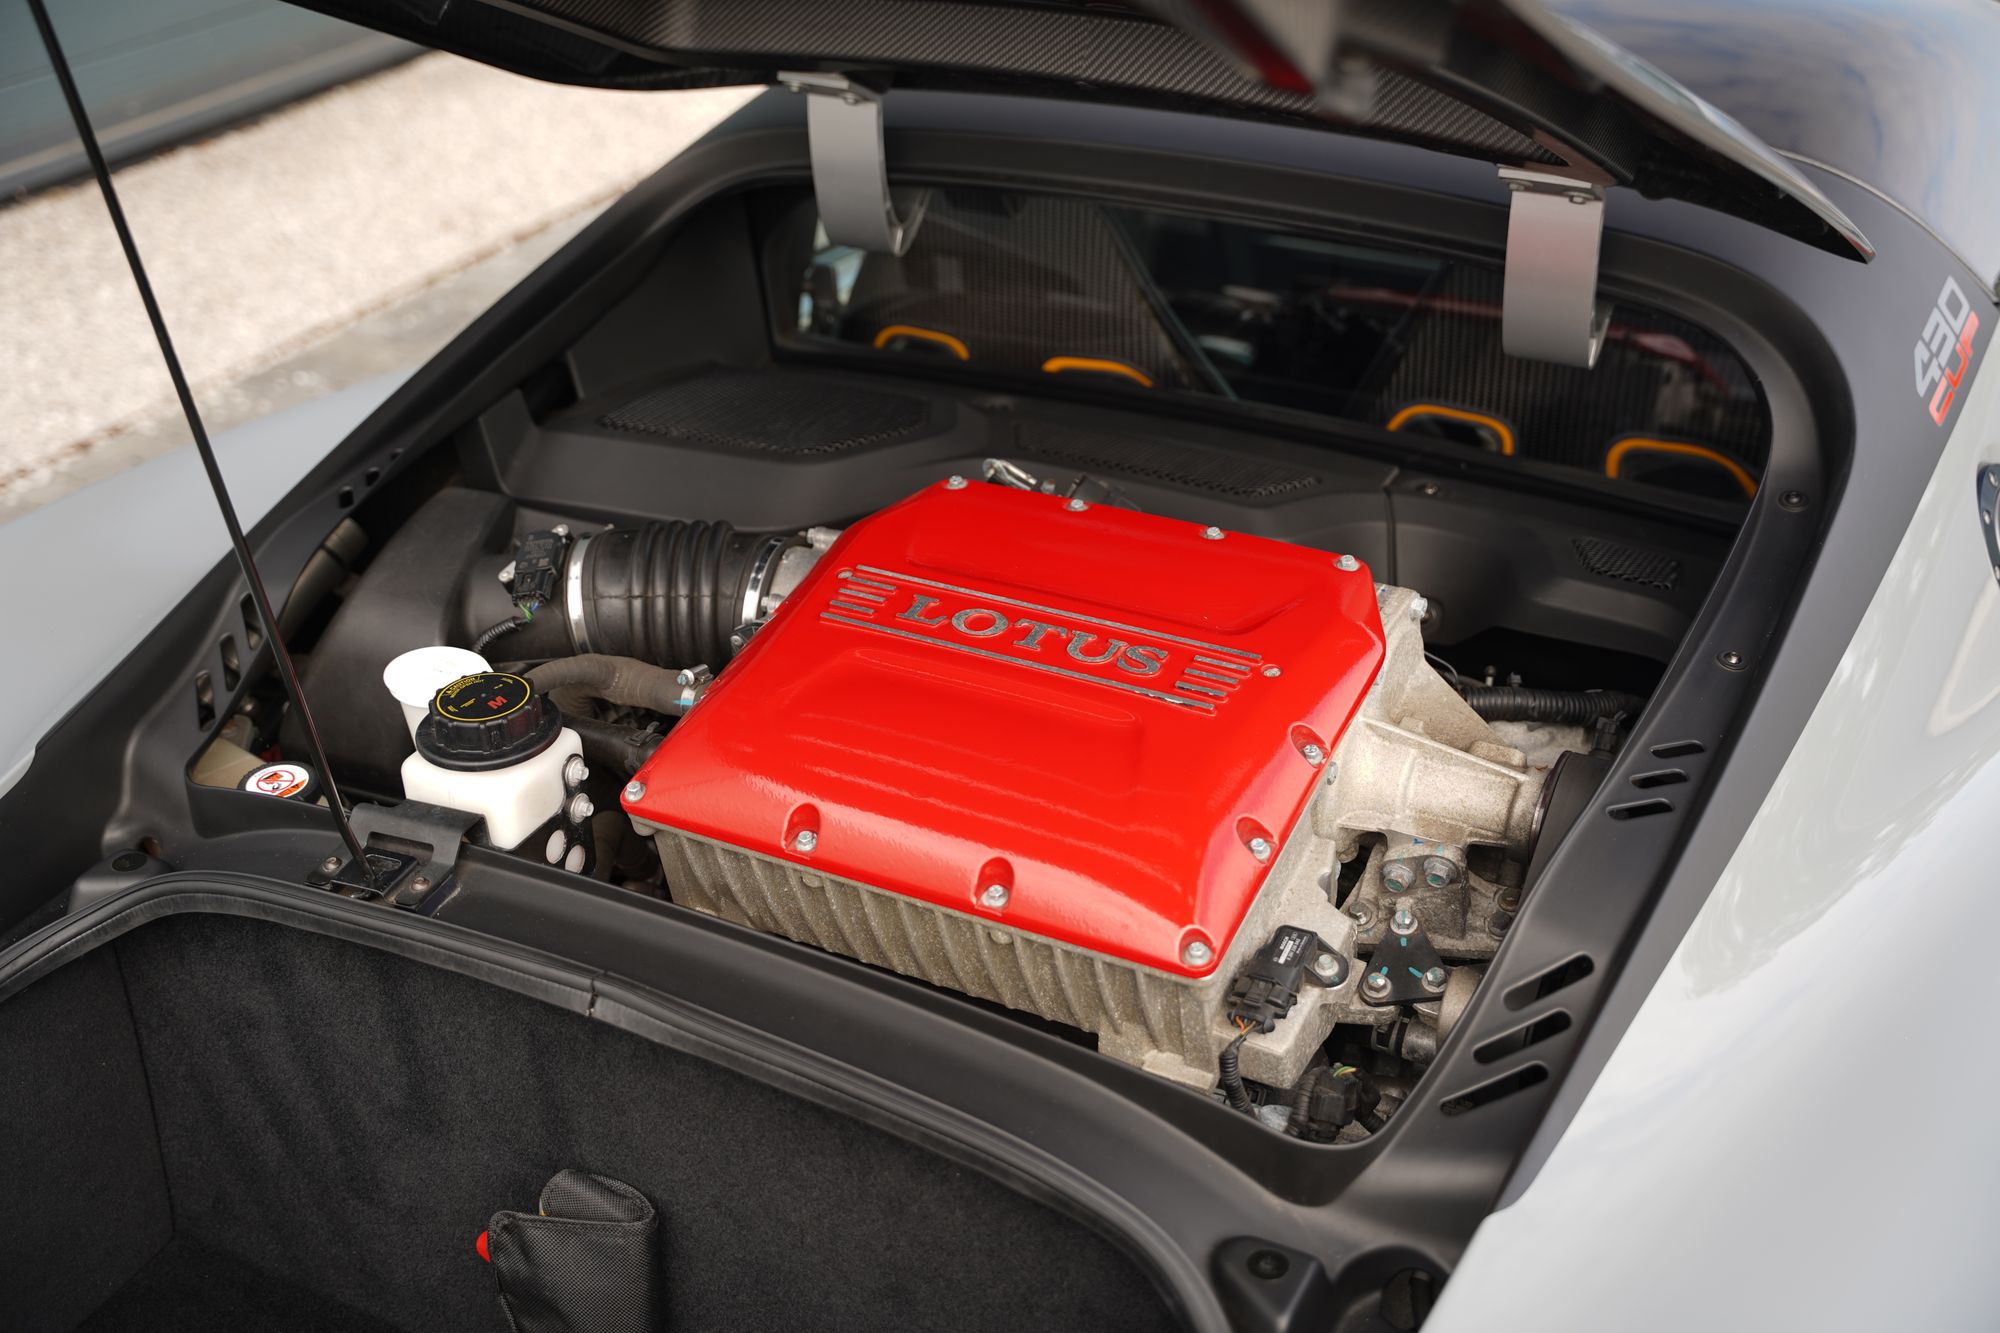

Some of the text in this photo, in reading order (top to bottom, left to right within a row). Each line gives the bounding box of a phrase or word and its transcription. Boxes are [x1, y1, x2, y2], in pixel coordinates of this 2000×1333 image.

[1914, 275, 1970, 398] 430
[1929, 310, 1979, 427] CUP
[895, 593, 1168, 676] LOTUS
[487, 695, 508, 709] M
[1280, 936, 1289, 950] BOSCH
